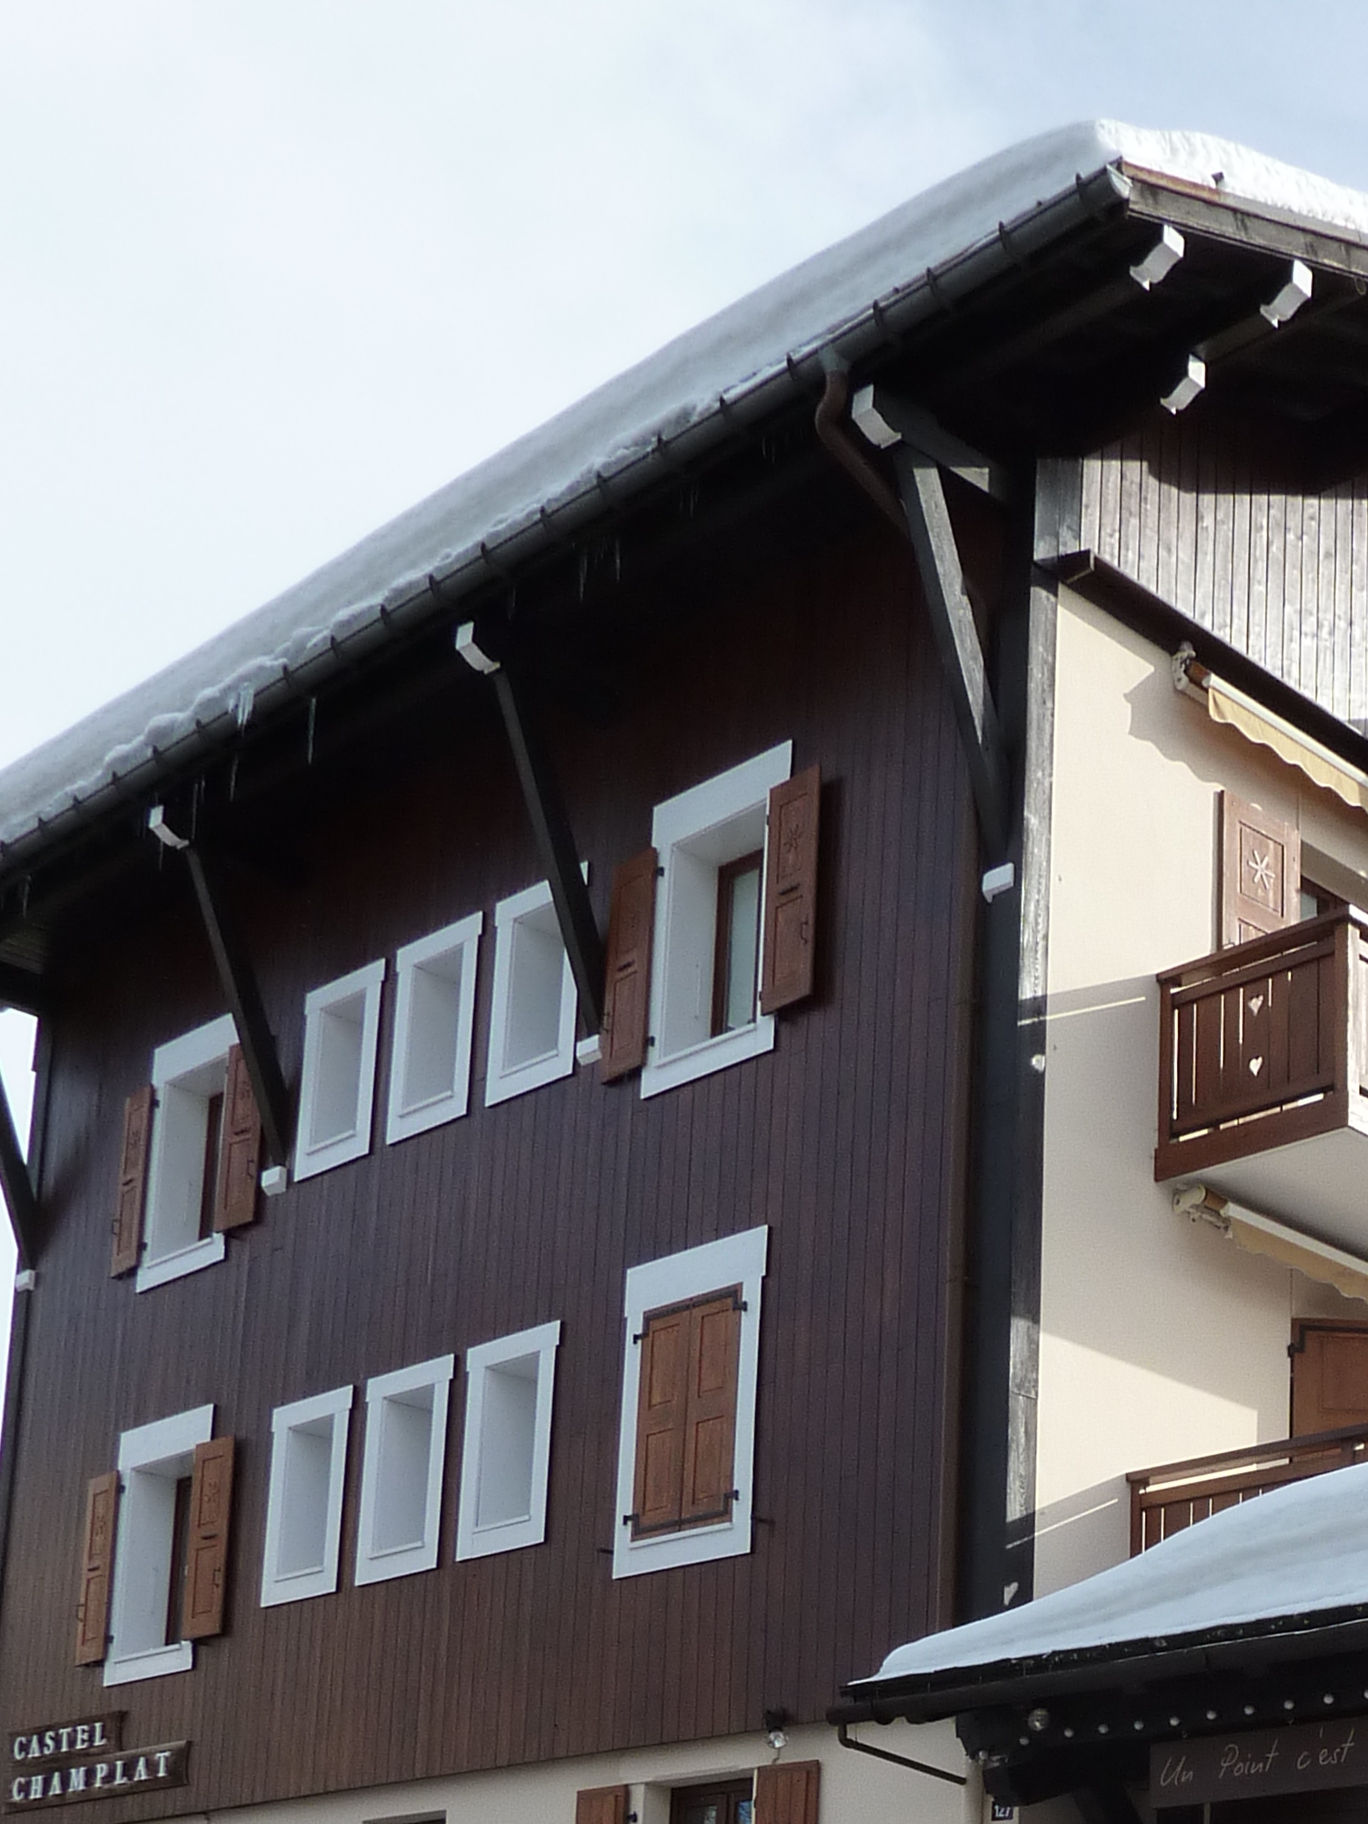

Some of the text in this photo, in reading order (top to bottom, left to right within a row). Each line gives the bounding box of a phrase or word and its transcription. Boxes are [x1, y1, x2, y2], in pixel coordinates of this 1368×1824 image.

[13, 1722, 107, 1760] CASTEL
[1159, 1756, 1194, 1787] Un
[1218, 1738, 1279, 1779] Point
[1296, 1726, 1355, 1770] c'est
[12, 1751, 171, 1803] CHAMPLAT
